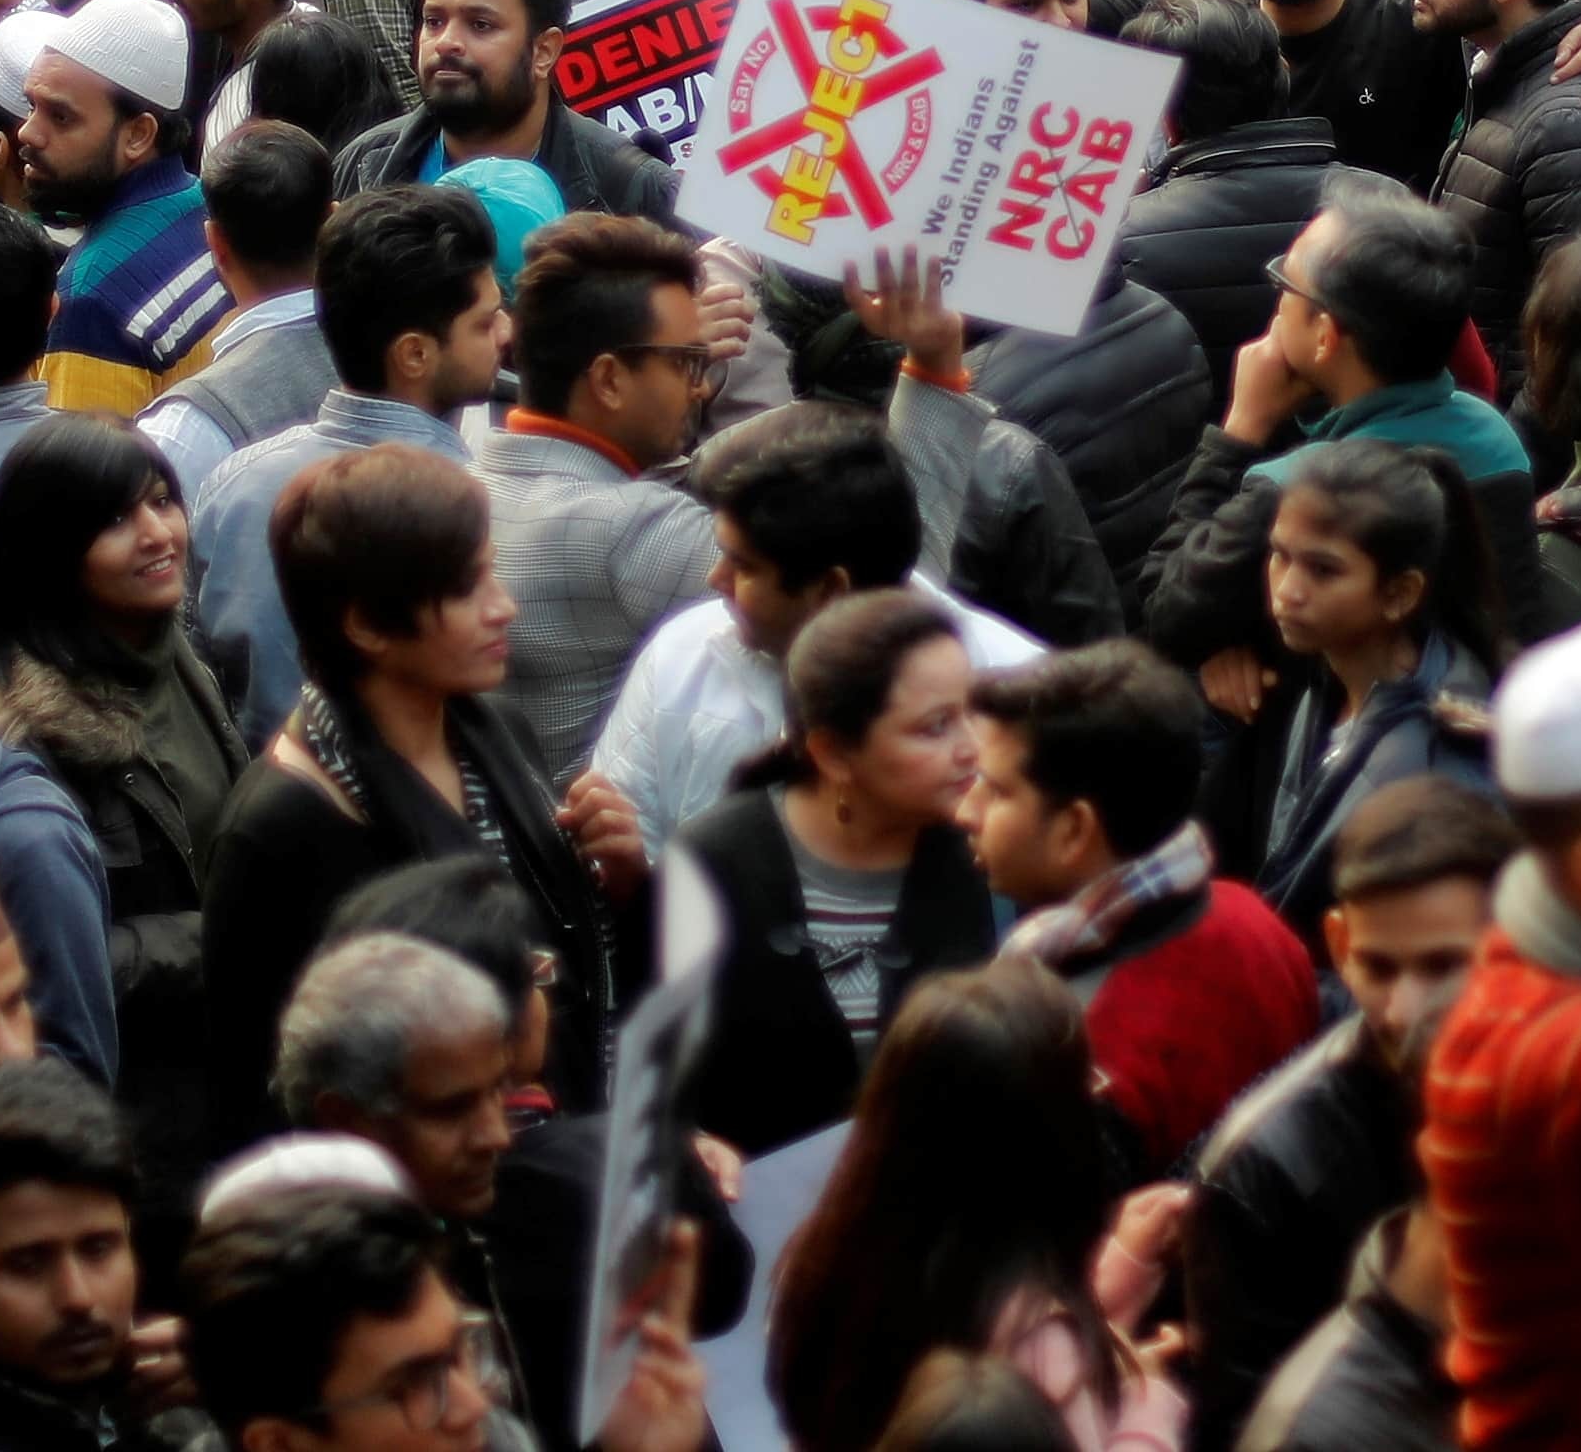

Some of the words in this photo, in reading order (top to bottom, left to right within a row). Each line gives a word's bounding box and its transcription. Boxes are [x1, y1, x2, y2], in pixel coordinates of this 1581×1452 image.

[743, 38, 770, 69] No
[730, 71, 758, 114] Say
[910, 97, 929, 134] CAB
[907, 137, 924, 153] &
[922, 194, 953, 235] We
[940, 76, 996, 185] Indians
[939, 161, 1001, 287] Standing
[984, 39, 1041, 153] Against
[885, 153, 915, 186] NRC
[985, 101, 1082, 253] NRC
[1044, 116, 1135, 262] CAB
